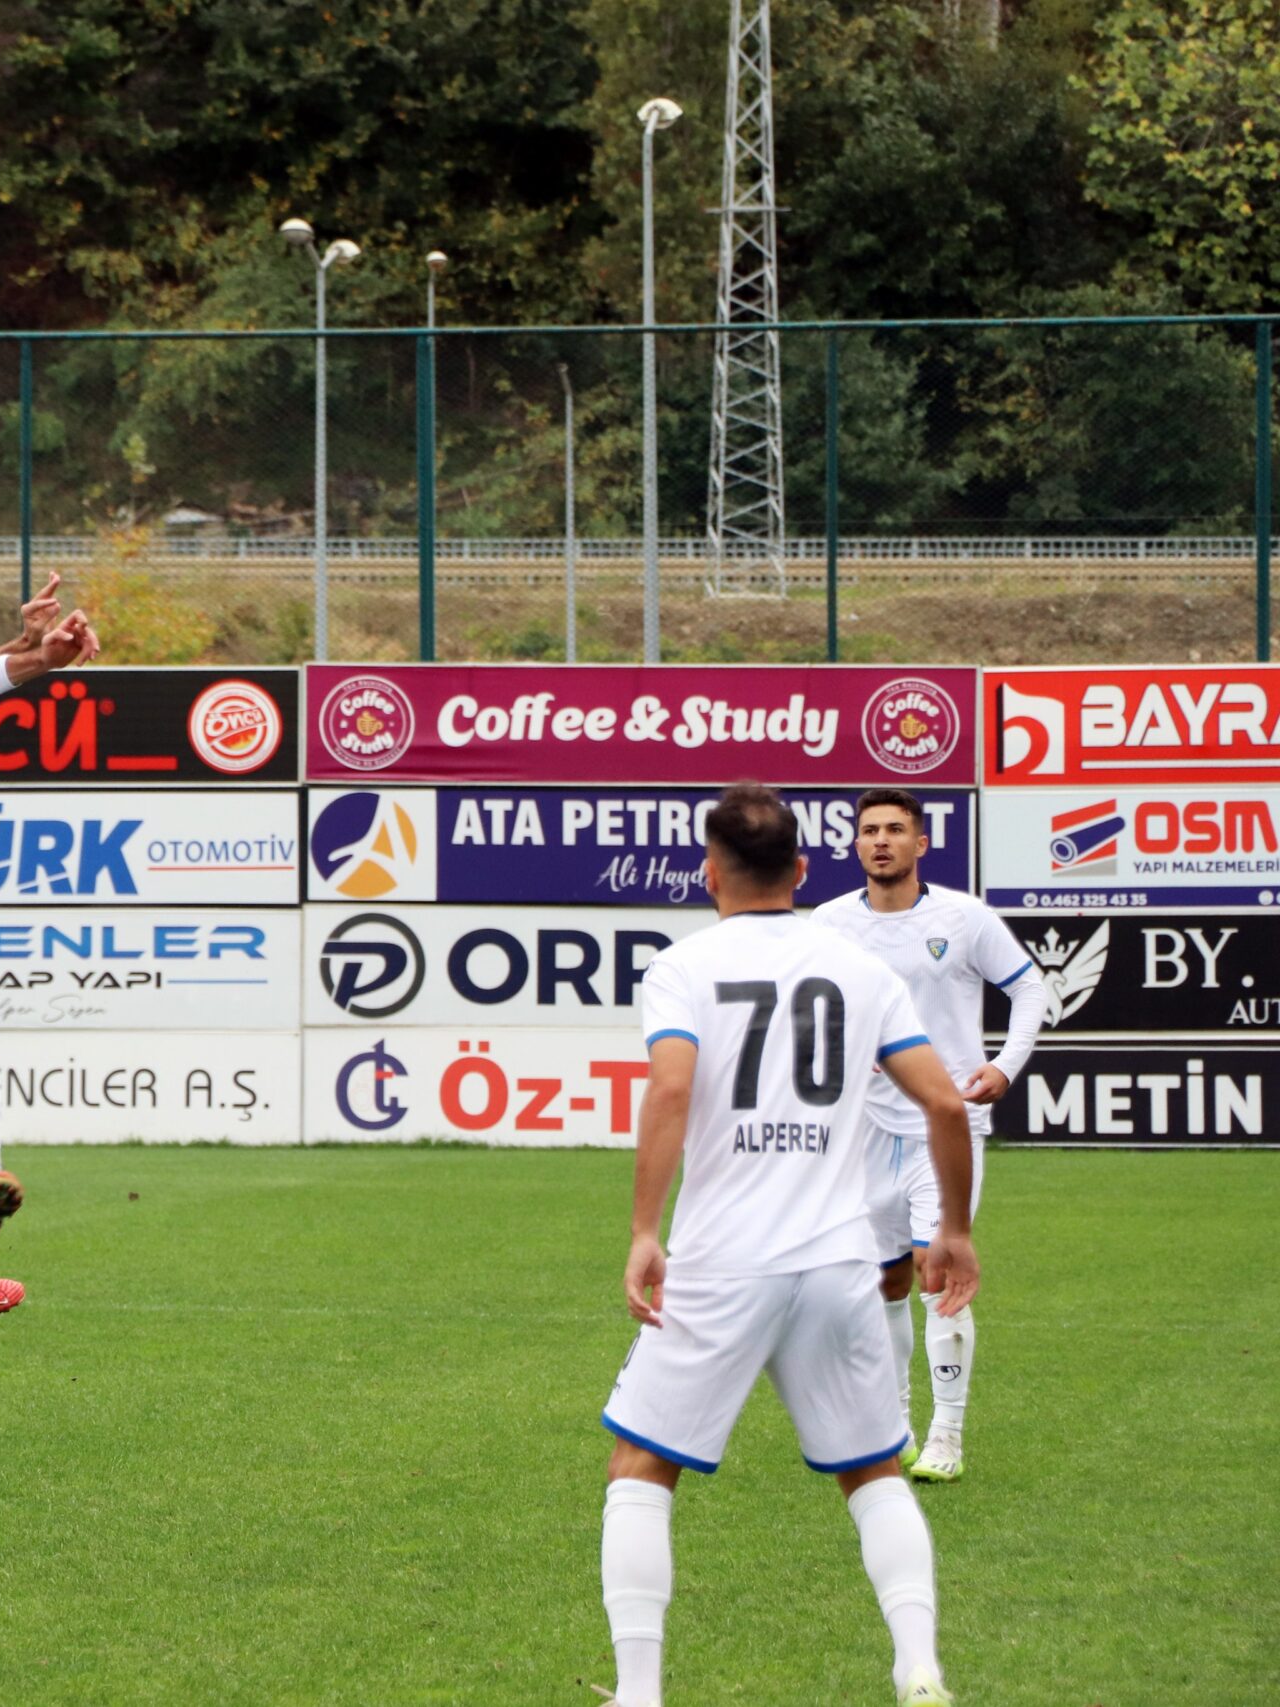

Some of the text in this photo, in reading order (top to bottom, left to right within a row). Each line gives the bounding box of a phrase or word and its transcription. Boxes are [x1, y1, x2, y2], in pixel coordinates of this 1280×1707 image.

[340, 690, 396, 717] Coffee
[883, 692, 940, 719] Coffee
[437, 693, 840, 757] Coffee & Study
[340, 731, 395, 755] Study
[883, 734, 939, 758] Study
[451, 800, 545, 846] ATA
[562, 800, 719, 847] PETRO
[147, 834, 295, 863] OTOMOTİV
[594, 854, 708, 903] Ali Hayd
[1133, 858, 1280, 873] YAPI MALZEMELERİ
[1082, 893, 1108, 906] 325
[1109, 893, 1128, 906] 43
[1130, 893, 1148, 906] 35
[69, 971, 162, 989] YAPI
[713, 976, 846, 1111] 70
[184, 1069, 270, 1122] A.Ş.
[1027, 1058, 1263, 1135] METİN
[732, 1122, 831, 1156] ALPEREN
